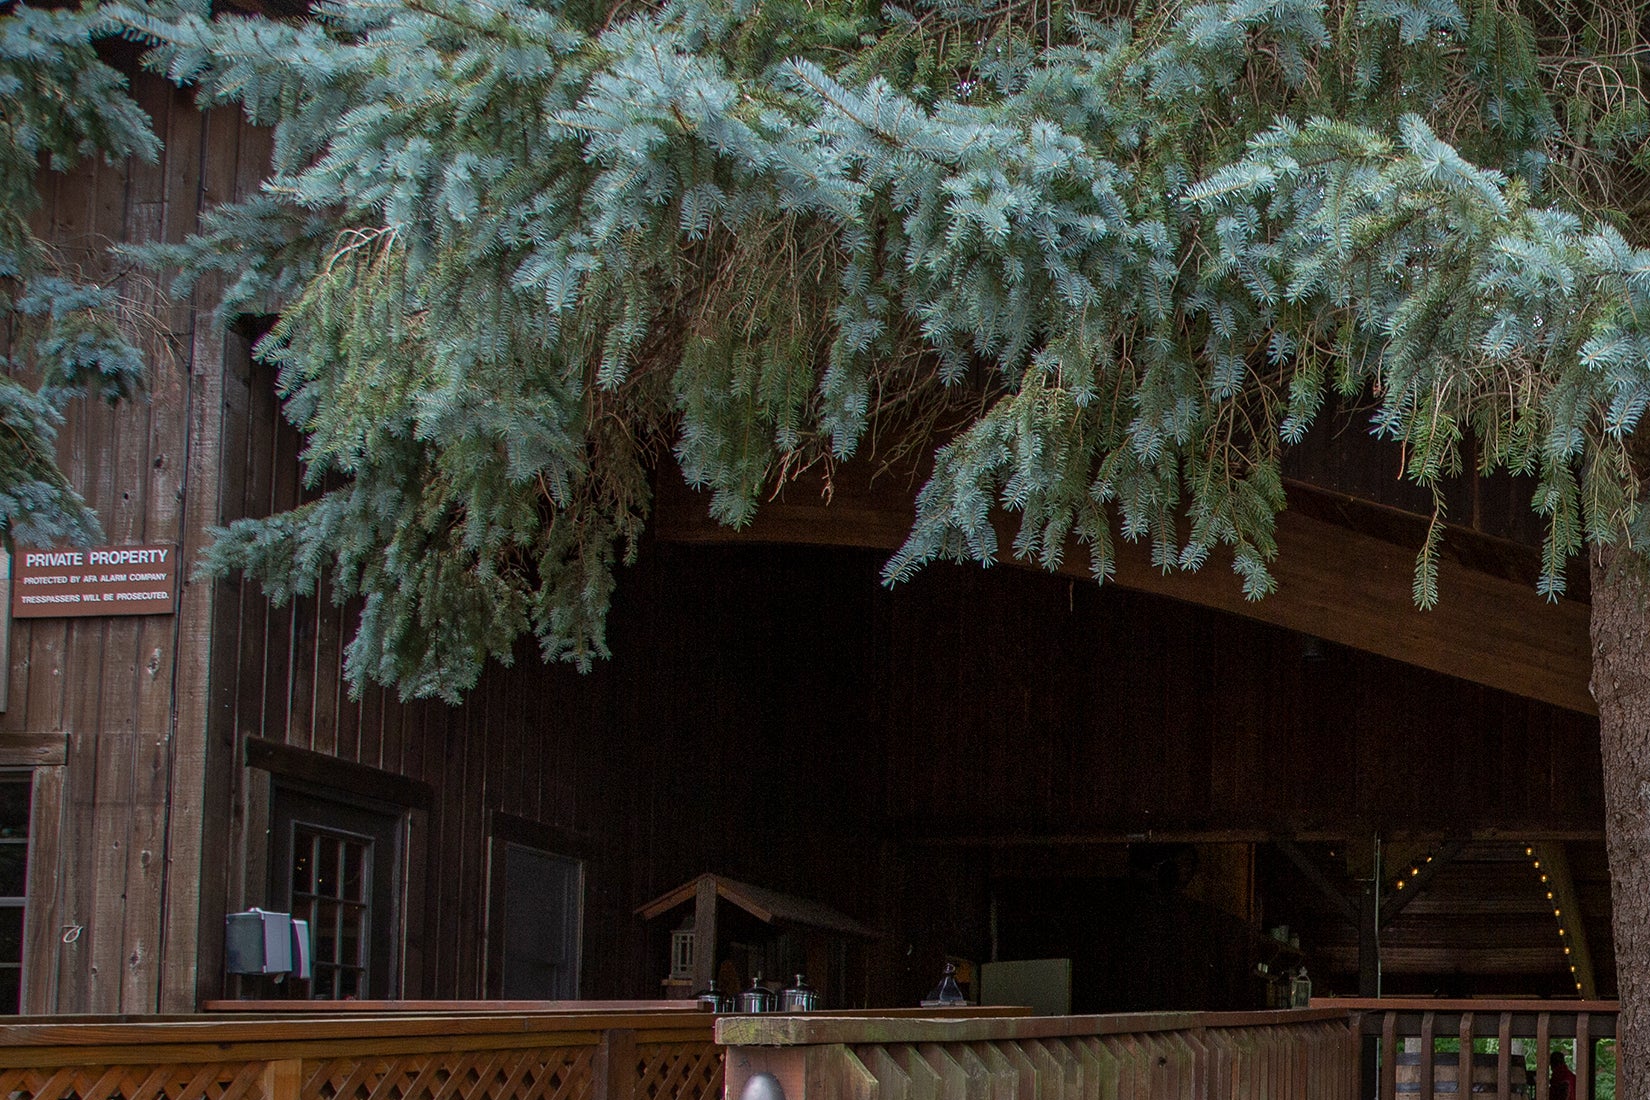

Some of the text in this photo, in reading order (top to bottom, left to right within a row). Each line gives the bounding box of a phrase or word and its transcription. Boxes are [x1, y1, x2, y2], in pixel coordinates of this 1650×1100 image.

[26, 549, 168, 567] PRIVATE PROPERTY
[24, 573, 167, 584] PROTECTED BY AFA ALARM COMPANY
[83, 594, 101, 602] WILL
[103, 593, 114, 601] BE
[117, 591, 169, 600] PROSECUTED.
